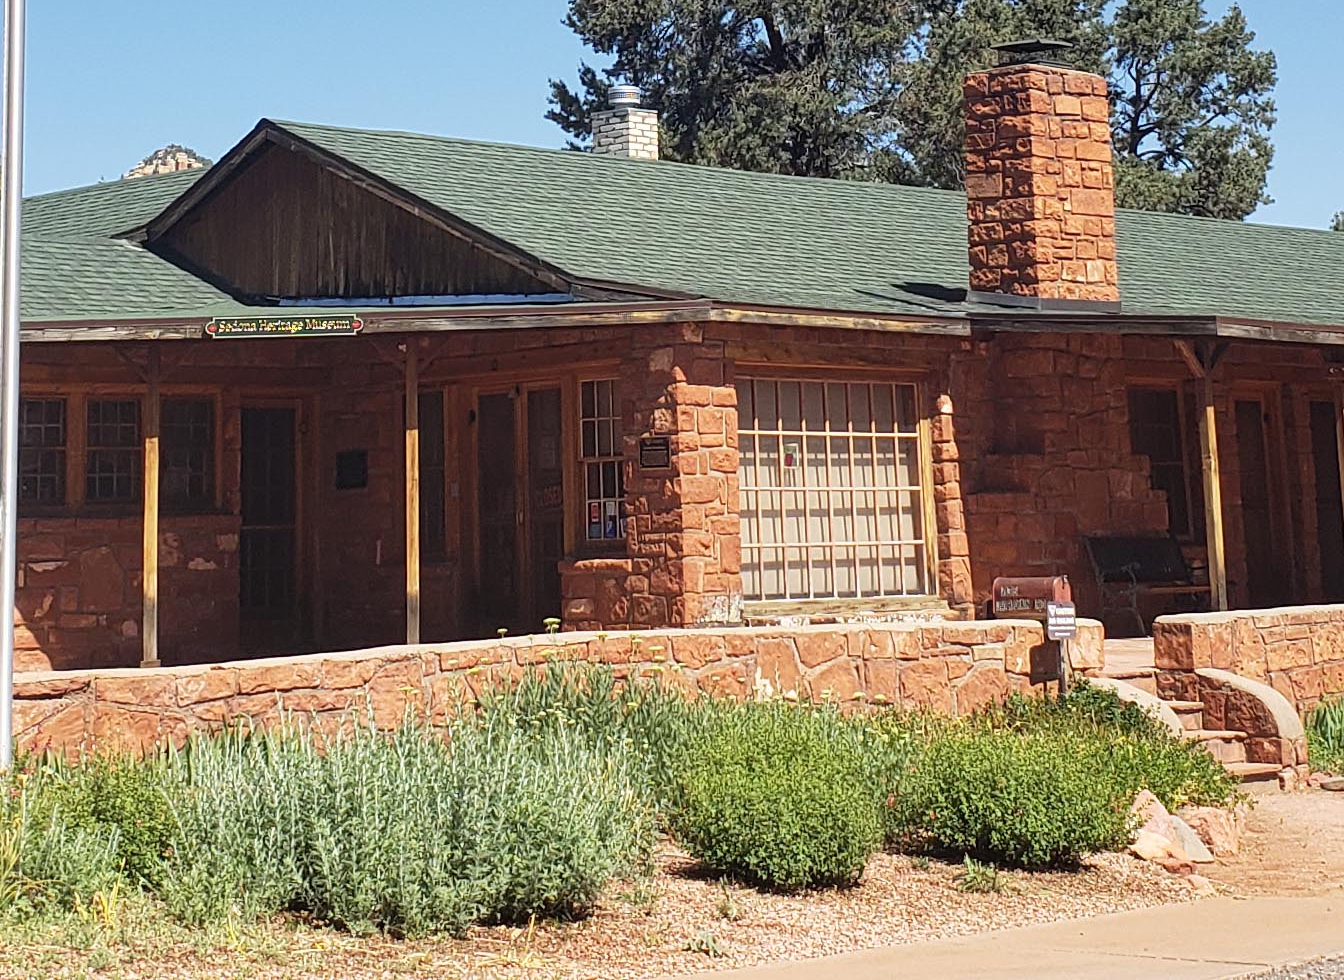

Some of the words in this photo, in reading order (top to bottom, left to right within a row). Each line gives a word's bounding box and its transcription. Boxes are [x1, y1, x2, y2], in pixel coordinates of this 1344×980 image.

[218, 320, 257, 333] Sedona
[258, 319, 304, 334] Heritage
[305, 318, 351, 330] Museum
